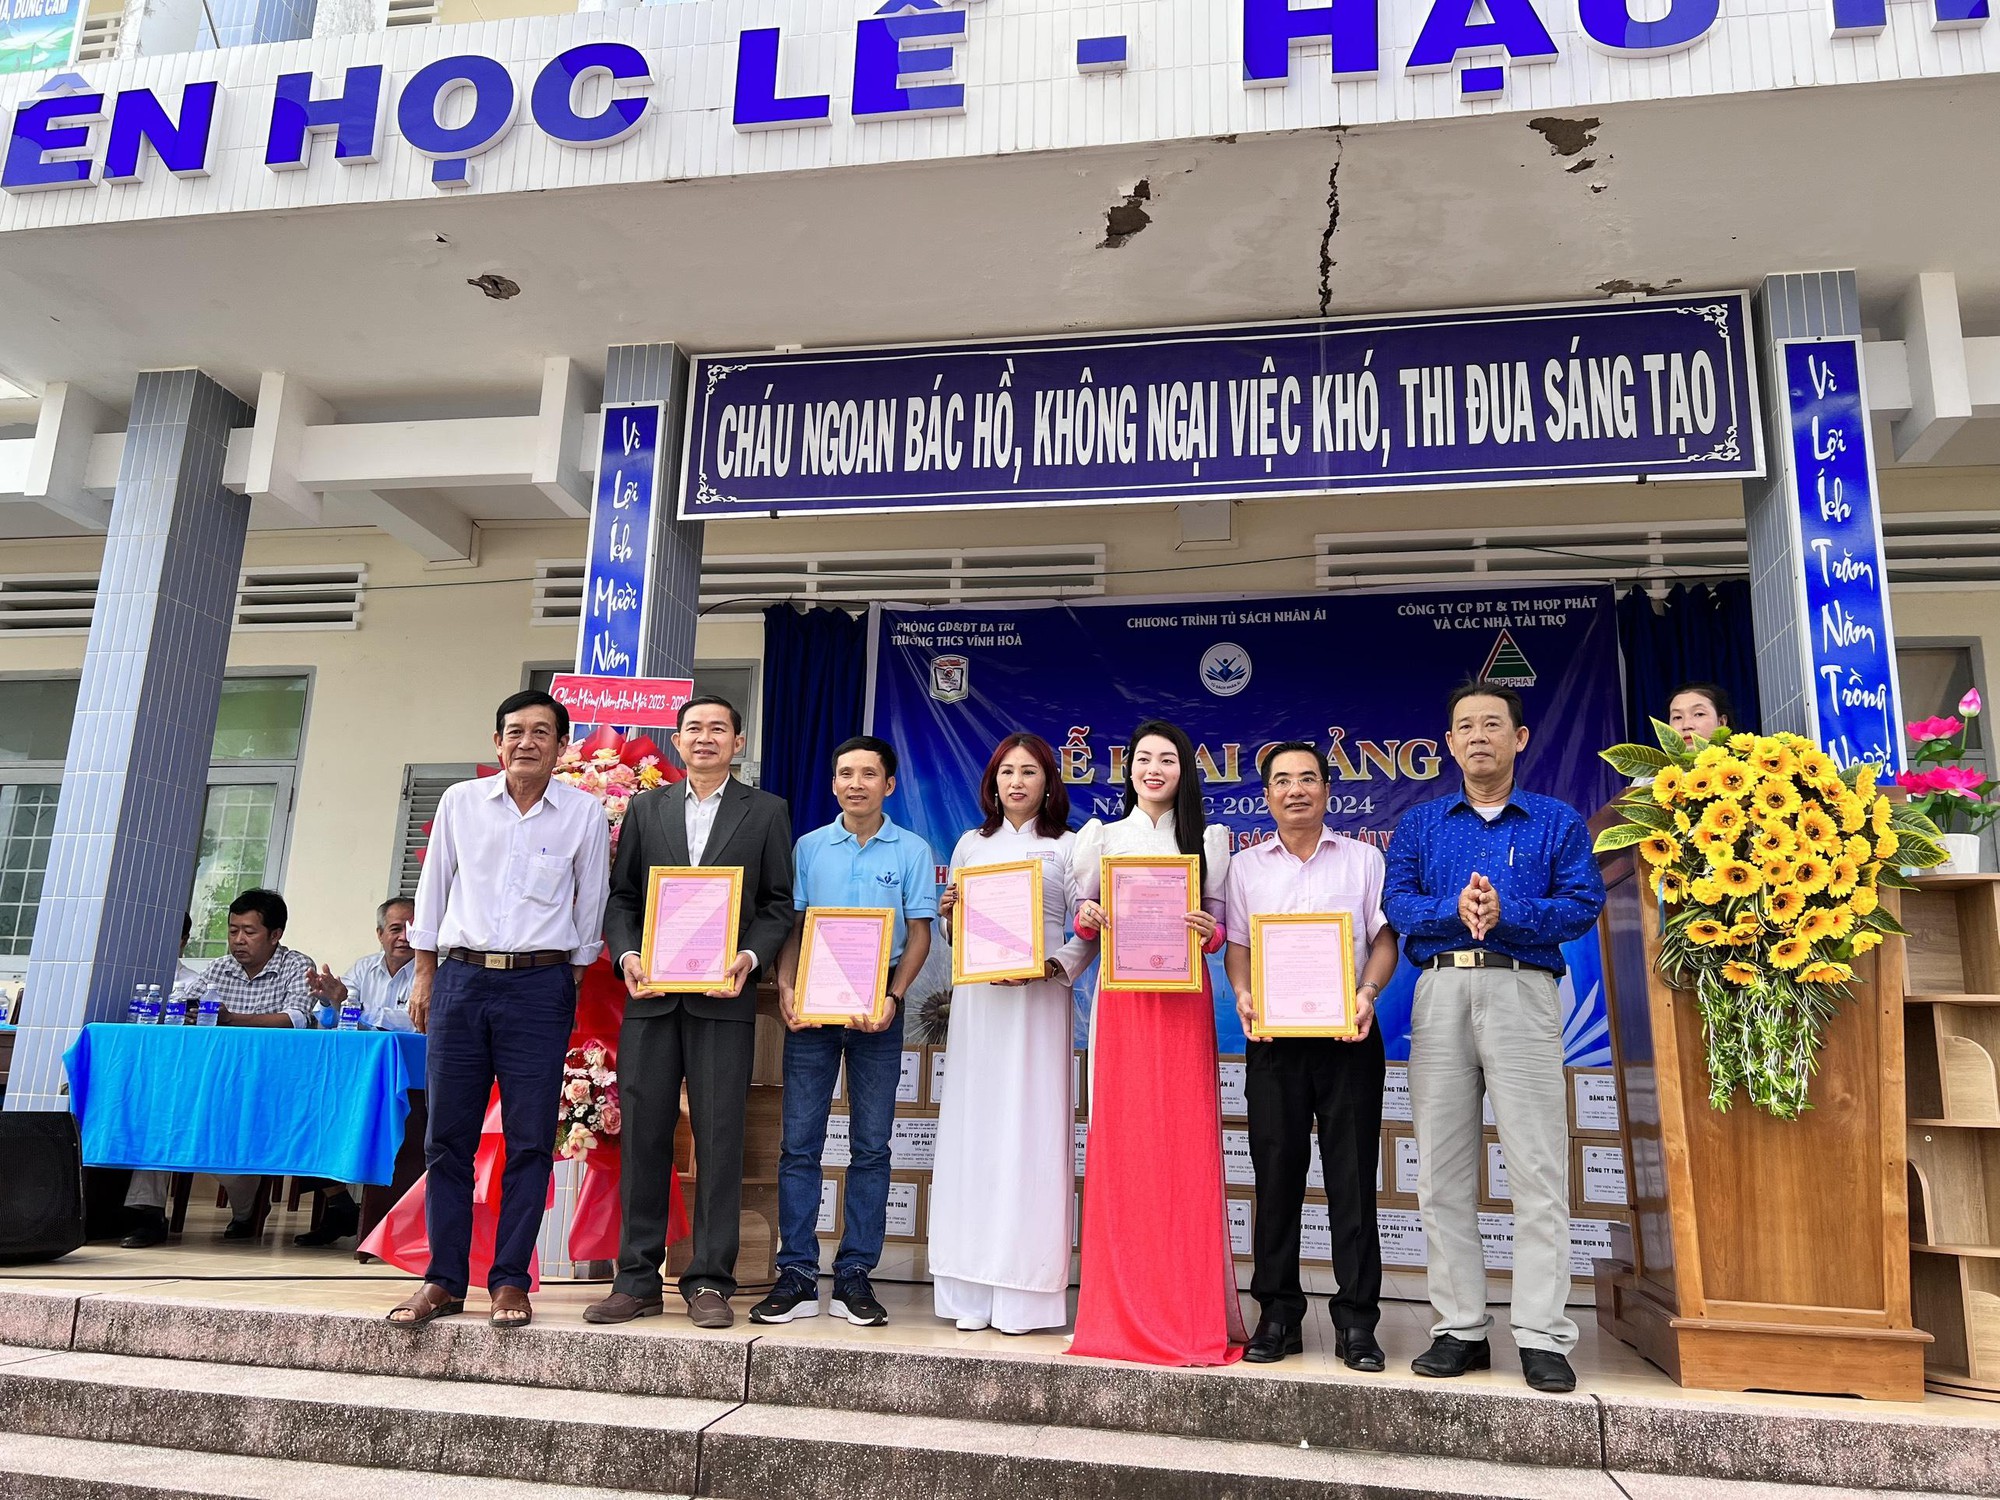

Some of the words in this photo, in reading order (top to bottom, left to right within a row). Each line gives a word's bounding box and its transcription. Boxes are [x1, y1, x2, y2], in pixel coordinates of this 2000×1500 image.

[265, 42, 654, 188] HỌC
[1808, 354, 1837, 400] Vì
[716, 384, 794, 479] CHÁU
[800, 398, 897, 476] NGOAN
[904, 374, 964, 473] BÁC
[973, 358, 1022, 484] HỒ,
[1033, 366, 1137, 467] KHÔNG
[1147, 380, 1218, 477] NGẠI
[1229, 356, 1302, 473] VIỆC
[1312, 349, 1390, 468] KHÓ,
[1399, 365, 1456, 448] THI
[1466, 361, 1536, 445] ĐUA
[1545, 336, 1638, 441] SÁNG
[1643, 349, 1717, 454] TẠO
[622, 416, 641, 456] Vì
[1811, 415, 1847, 463] Lợi
[613, 470, 638, 510] Lợi
[1817, 467, 1852, 523] Ích
[610, 516, 633, 563] Ích
[1811, 538, 1874, 591] Trăm
[593, 576, 637, 623] Mười
[1127, 616, 1178, 628] CHƯƠNG
[1181, 613, 1217, 626] TRÌNH
[1220, 611, 1236, 624] TỦ
[1240, 611, 1271, 624] SÁCH
[1274, 609, 1310, 622] NHÂN
[1313, 608, 1327, 620] ÁI
[1397, 603, 1435, 616] CÔNG
[1439, 604, 1453, 614] TY
[1457, 603, 1473, 613] CP
[1476, 602, 1492, 613] ĐT
[1496, 601, 1507, 611] &
[1511, 600, 1530, 611] TM
[1533, 598, 1561, 611] HỢP
[1564, 595, 1597, 609] PHÁT
[1434, 617, 1451, 629] VÀ
[1454, 616, 1480, 629] CÁC
[1484, 614, 1512, 628] NHÀ
[1515, 614, 1536, 627] TÀI
[1539, 613, 1566, 627] TRỢ
[891, 634, 933, 647] TRƯỜNG
[936, 635, 964, 647] THCS
[967, 634, 994, 647] VĨNH
[997, 633, 1022, 646] HOÀ
[896, 621, 935, 633] PHÒNG
[938, 621, 977, 633] GD&ĐT
[980, 623, 994, 633] BA
[998, 622, 1015, 631] TRI
[1821, 600, 1875, 654] Năm
[591, 630, 629, 676] Năm
[648, 694, 665, 710] 2023
[1820, 664, 1891, 754] Trồng
[1057, 726, 1095, 784] Ễ
[1092, 794, 1124, 816] NĂ
[1223, 796, 1269, 816] 202
[1326, 796, 1375, 815] 024
